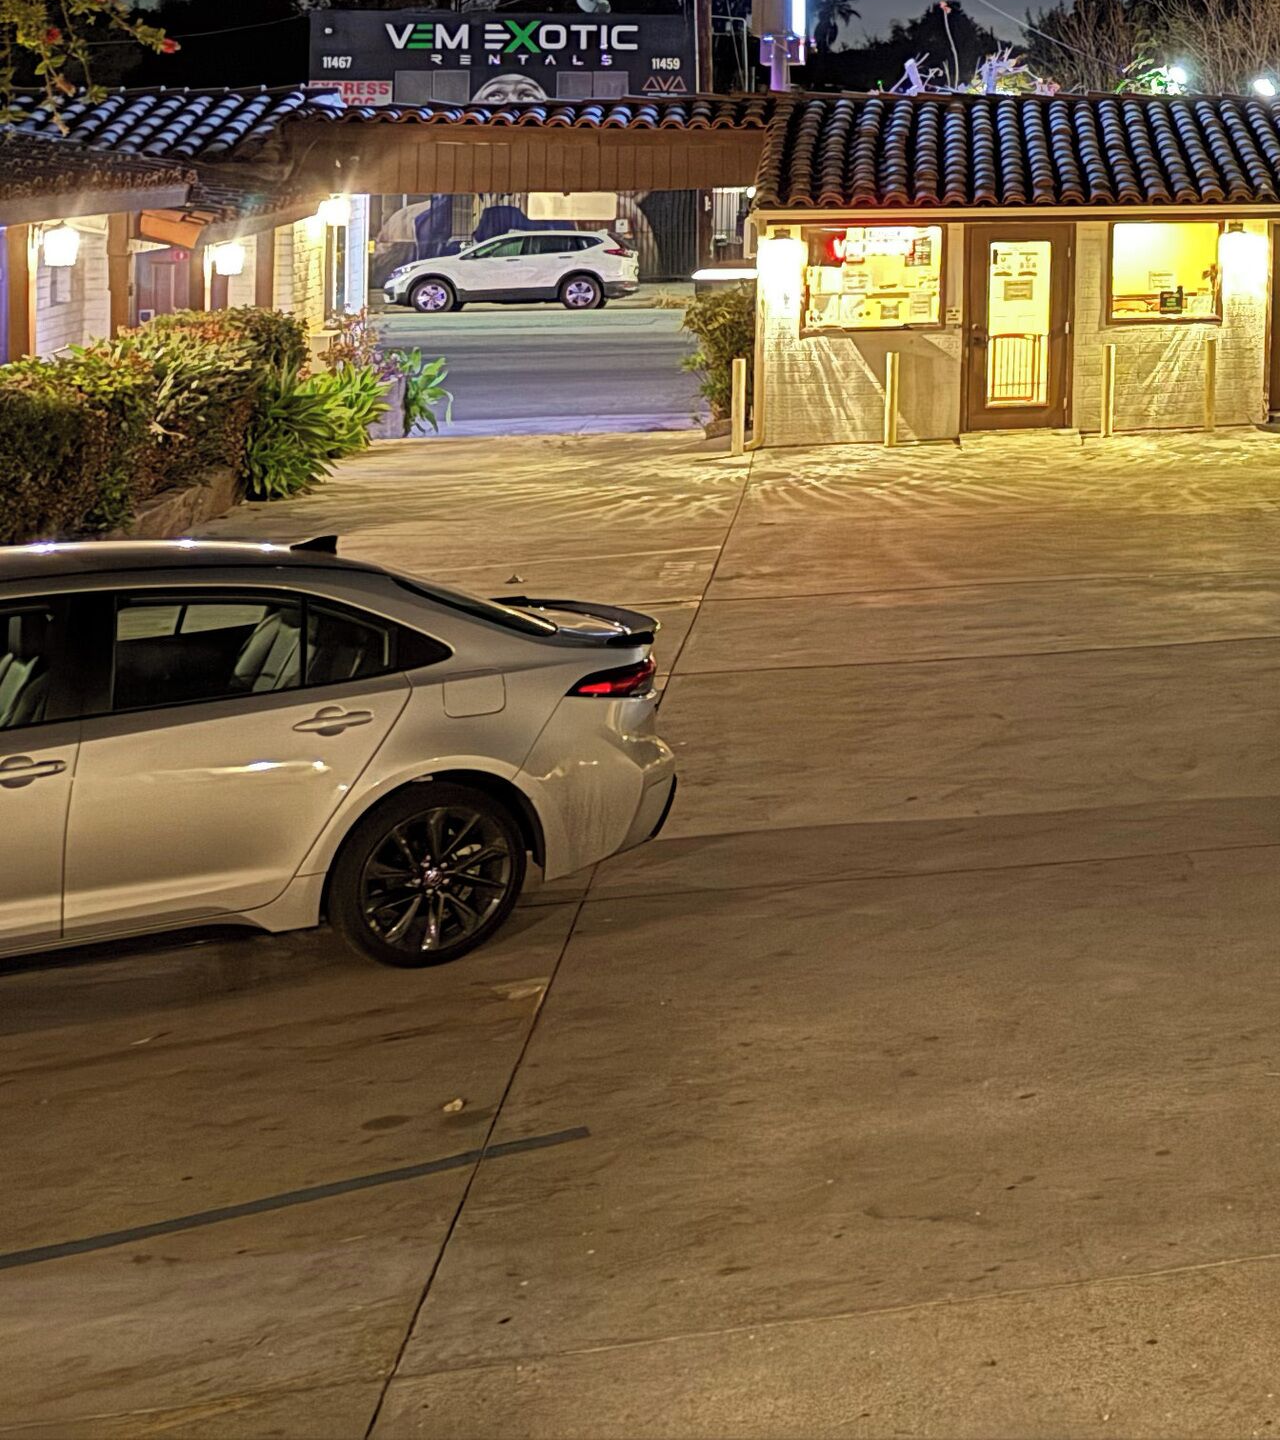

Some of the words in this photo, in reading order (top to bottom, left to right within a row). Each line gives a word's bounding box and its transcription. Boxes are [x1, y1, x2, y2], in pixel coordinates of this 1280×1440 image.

[385, 23, 469, 50] VEM
[484, 20, 639, 54] EXOTIC
[323, 56, 352, 69] 11467
[430, 54, 613, 65] RENTALS
[651, 57, 681, 70] 11459
